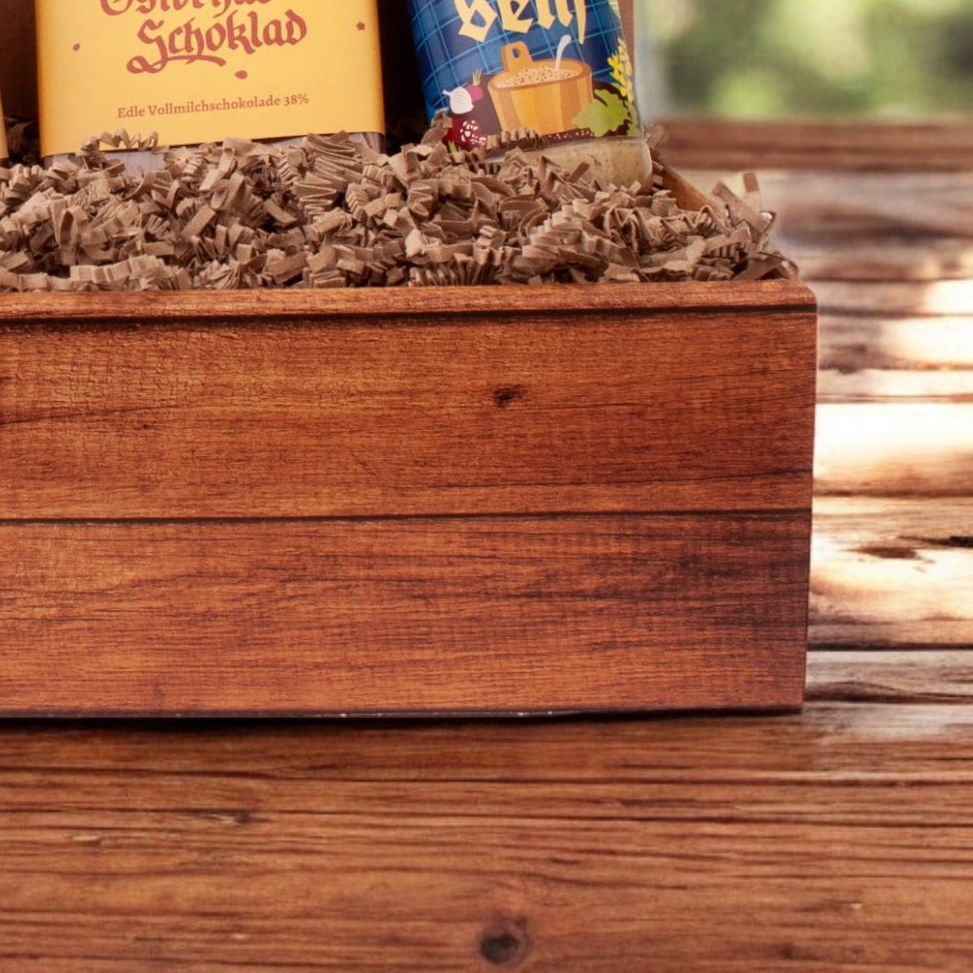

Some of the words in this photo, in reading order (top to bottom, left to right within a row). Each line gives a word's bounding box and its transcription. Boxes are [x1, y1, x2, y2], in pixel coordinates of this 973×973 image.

[126, 9, 307, 73] Schoklad
[117, 105, 145, 119] Edle
[148, 94, 281, 116] Vollmilchschokolade
[283, 92, 310, 107] 38%
